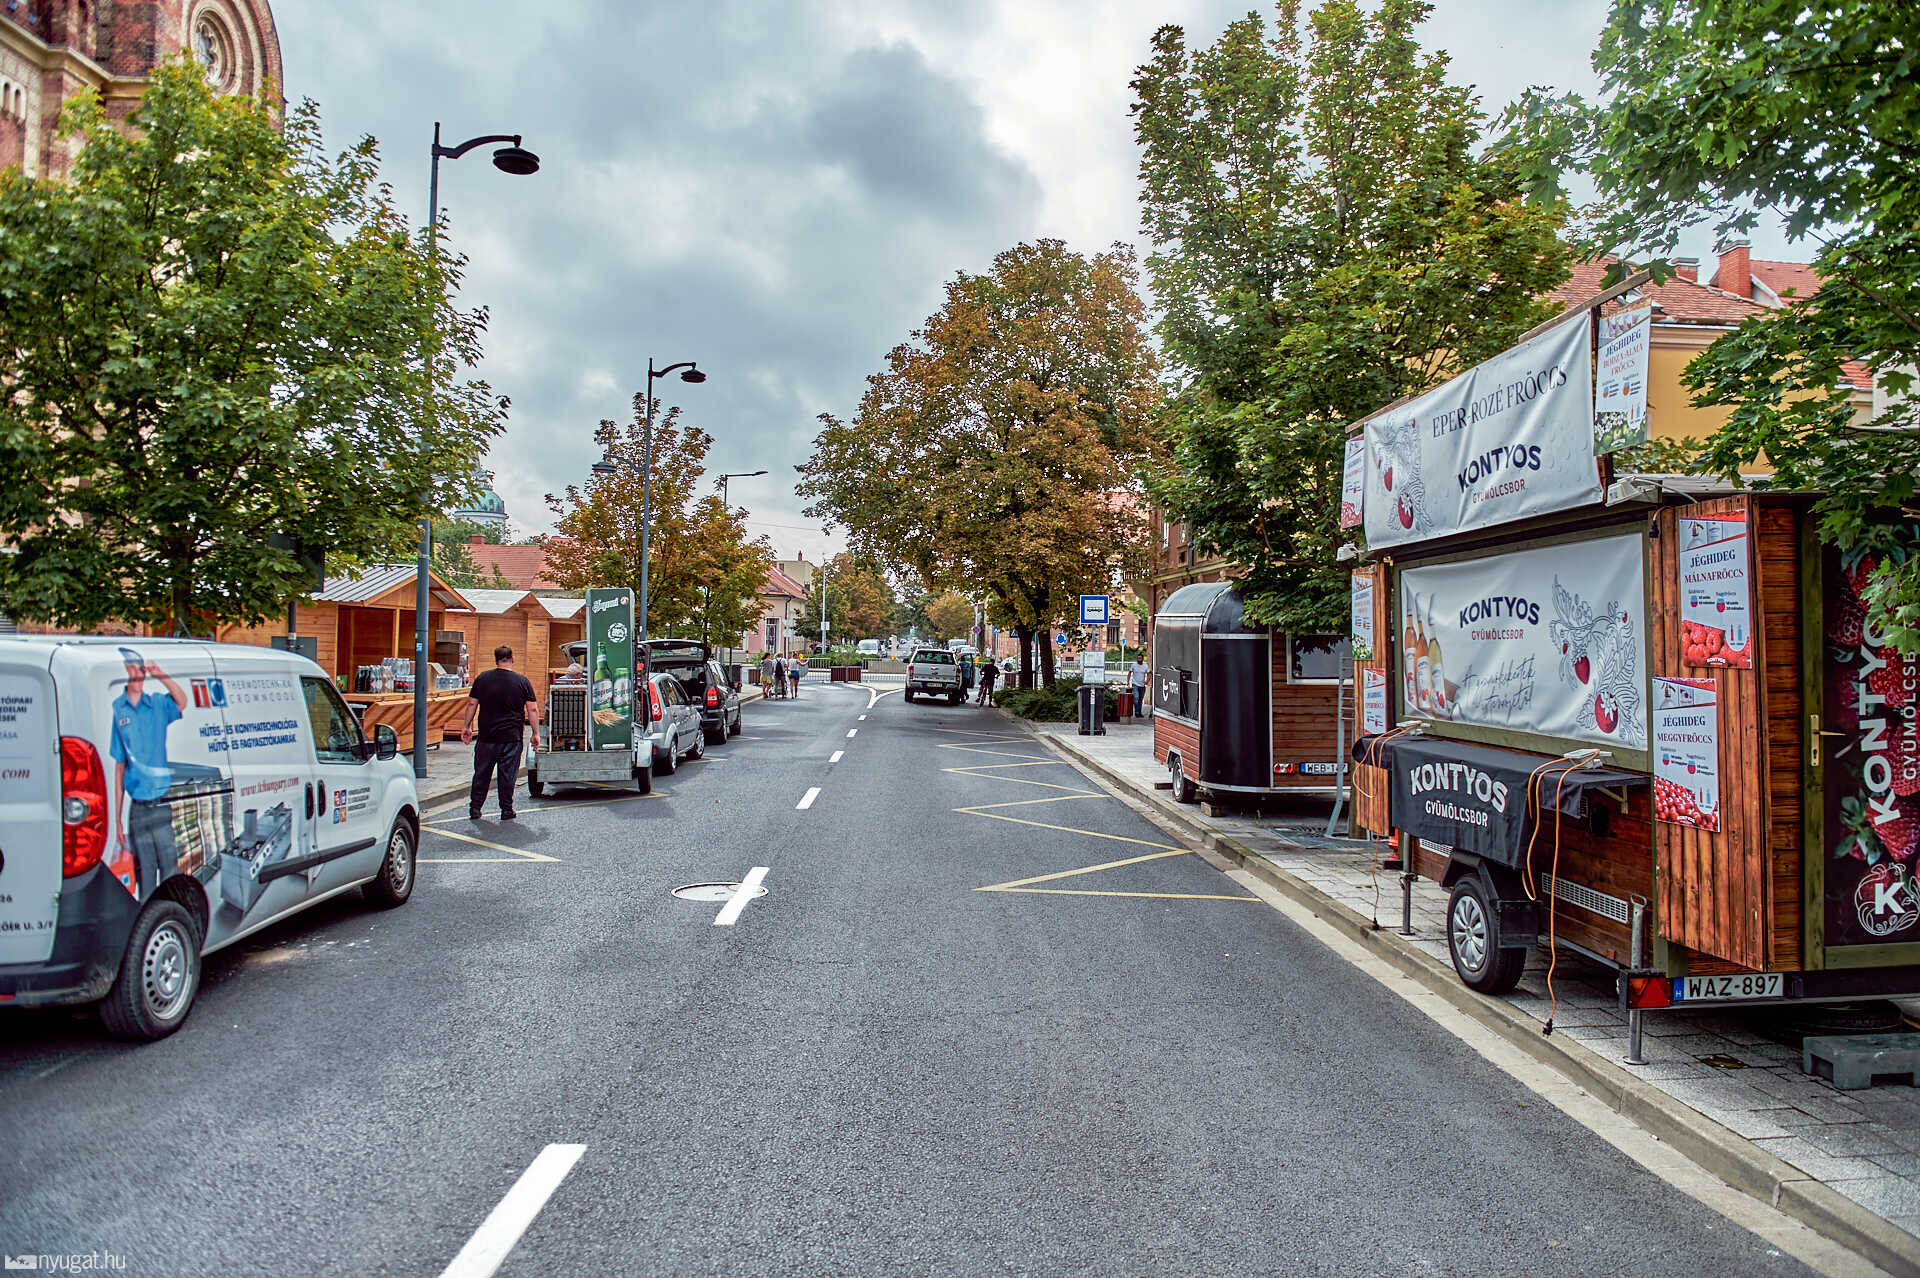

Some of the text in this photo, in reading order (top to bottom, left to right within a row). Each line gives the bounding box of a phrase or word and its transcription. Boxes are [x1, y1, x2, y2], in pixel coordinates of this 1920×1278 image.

[1432, 364, 1567, 438] EPER-ROZÉ FRÖCCS
[1458, 443, 1541, 493] KONTYOS
[1472, 478, 1526, 504] GYÜMÖLCSBOR
[1690, 549, 1736, 568] JÉGHIDEG
[1684, 568, 1744, 584] MÁLNAFRÖCCS
[1460, 596, 1540, 629] KONTYOS
[1472, 629, 1524, 640] GYÜMÖLCSBOR
[1663, 715, 1706, 727] JÉGHIDEG
[1859, 612, 1901, 826] KONTYO
[1901, 650, 1917, 780] GYÜMÖLCSB
[1657, 732, 1713, 744] MEGGYFRÖCCS
[1410, 763, 1508, 813] KONTYOS
[1425, 800, 1488, 827] GYÜMÖLCSBOR
[1688, 975, 1779, 998] WAZ-897
